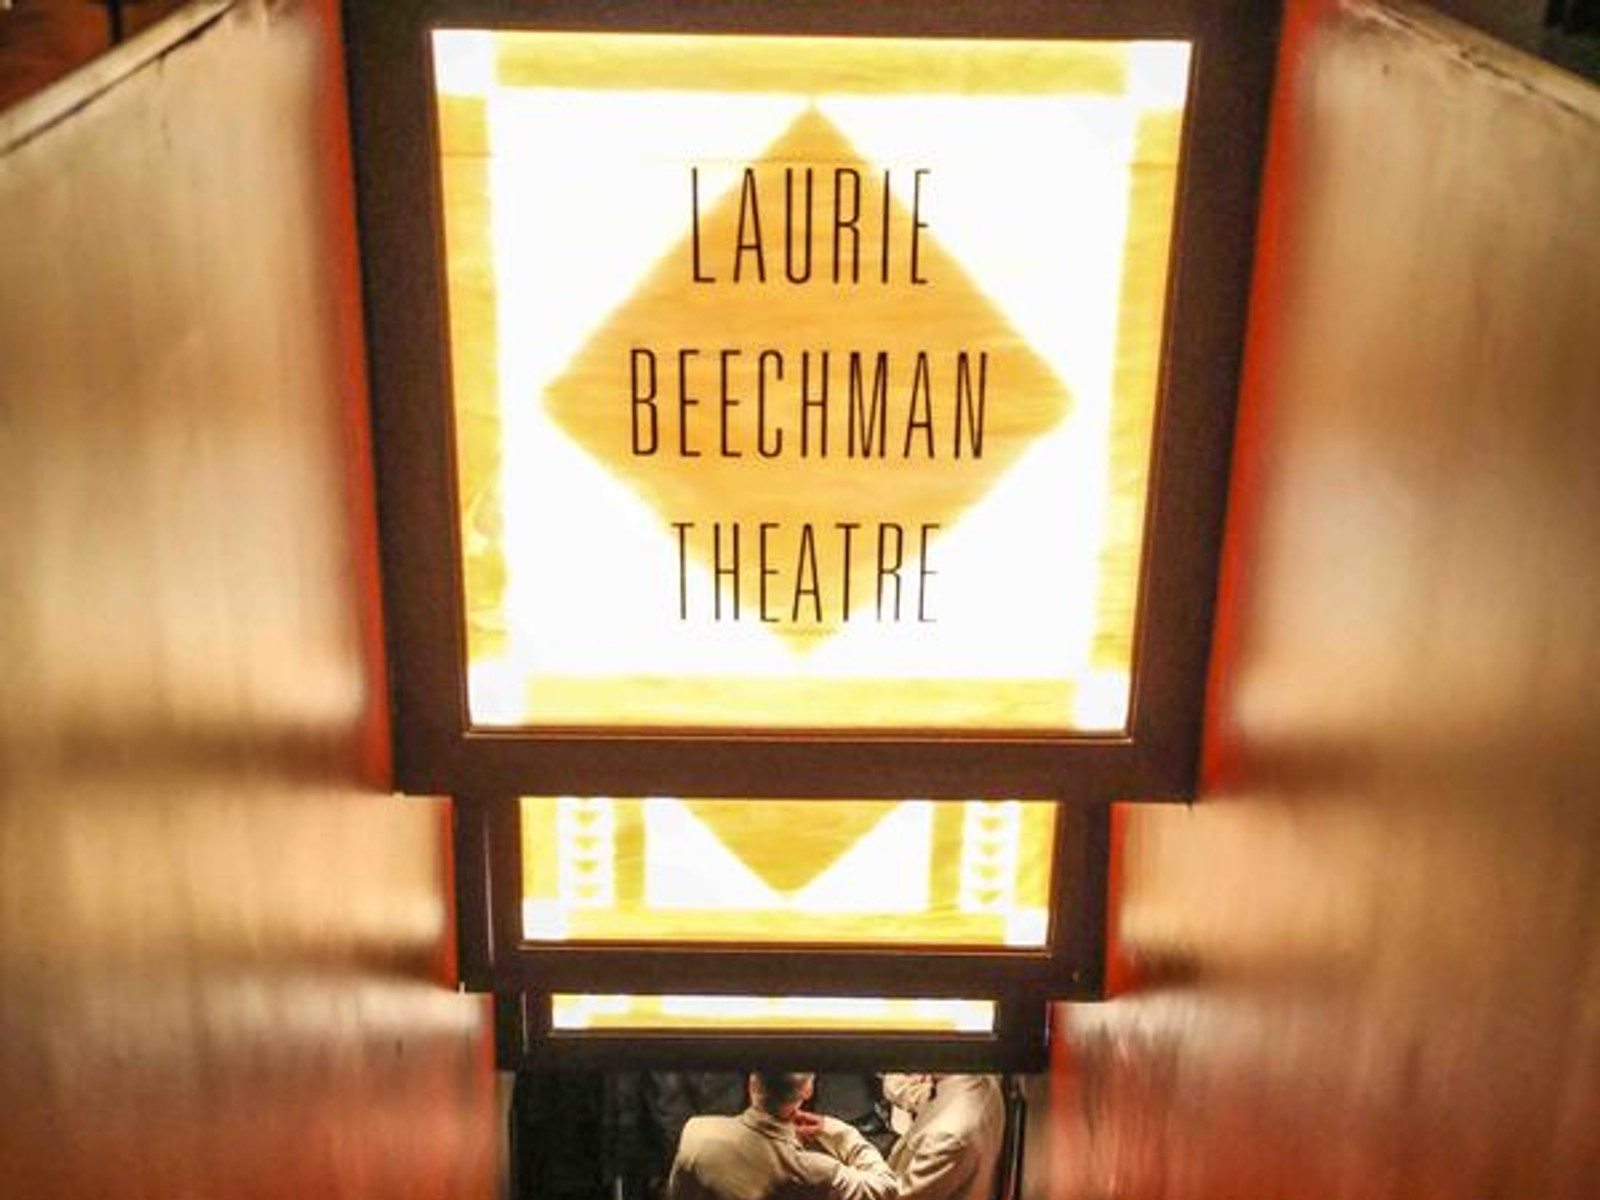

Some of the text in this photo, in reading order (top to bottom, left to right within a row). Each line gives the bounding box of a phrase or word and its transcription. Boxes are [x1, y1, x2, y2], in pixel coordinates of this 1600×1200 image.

[691, 167, 931, 285] LAURIE
[630, 348, 988, 460] BEECHMAN
[672, 522, 940, 624] THEATRE
